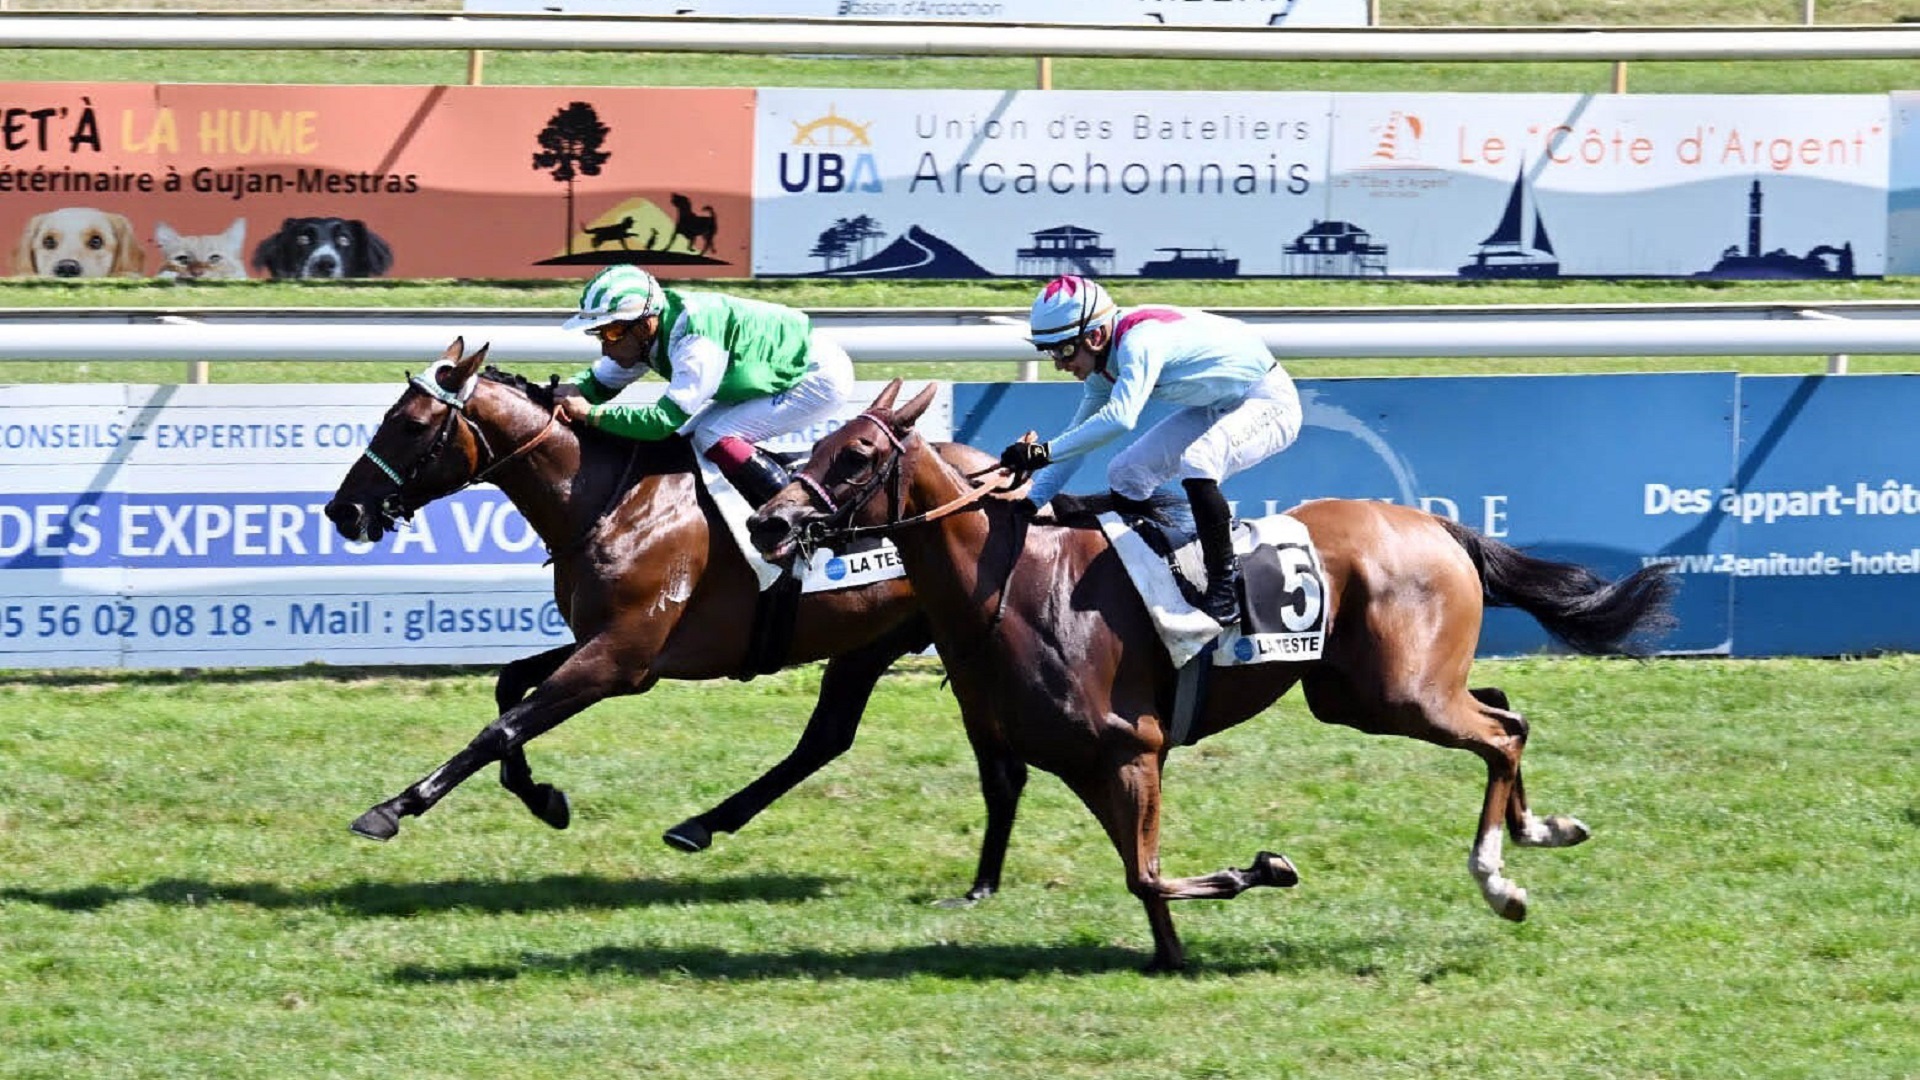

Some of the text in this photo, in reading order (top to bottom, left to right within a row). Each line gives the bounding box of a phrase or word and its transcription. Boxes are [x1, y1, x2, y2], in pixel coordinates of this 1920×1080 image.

[0, 96, 318, 154] ET'À LA HUME
[915, 112, 1310, 141] Union des Bateliers
[1459, 126, 1505, 164] Le
[164, 165, 181, 192] à
[191, 168, 419, 199] Gujan-Mestras
[778, 151, 883, 194] UBA
[909, 151, 1310, 195] Arcachonnais
[0, 424, 121, 448] ONSEILS
[157, 424, 303, 448] EXPERTISE
[1644, 479, 1920, 523] Des appart-hôt
[0, 504, 101, 556] DES
[119, 503, 376, 555] EXPERT
[450, 501, 547, 552] VO
[850, 556, 871, 573] LA
[1277, 547, 1321, 632] 5
[0, 605, 23, 637] 5
[38, 605, 81, 637] 56
[94, 605, 138, 637] 02
[151, 605, 194, 637] 08
[210, 604, 252, 637] 18
[290, 601, 371, 634] Mail
